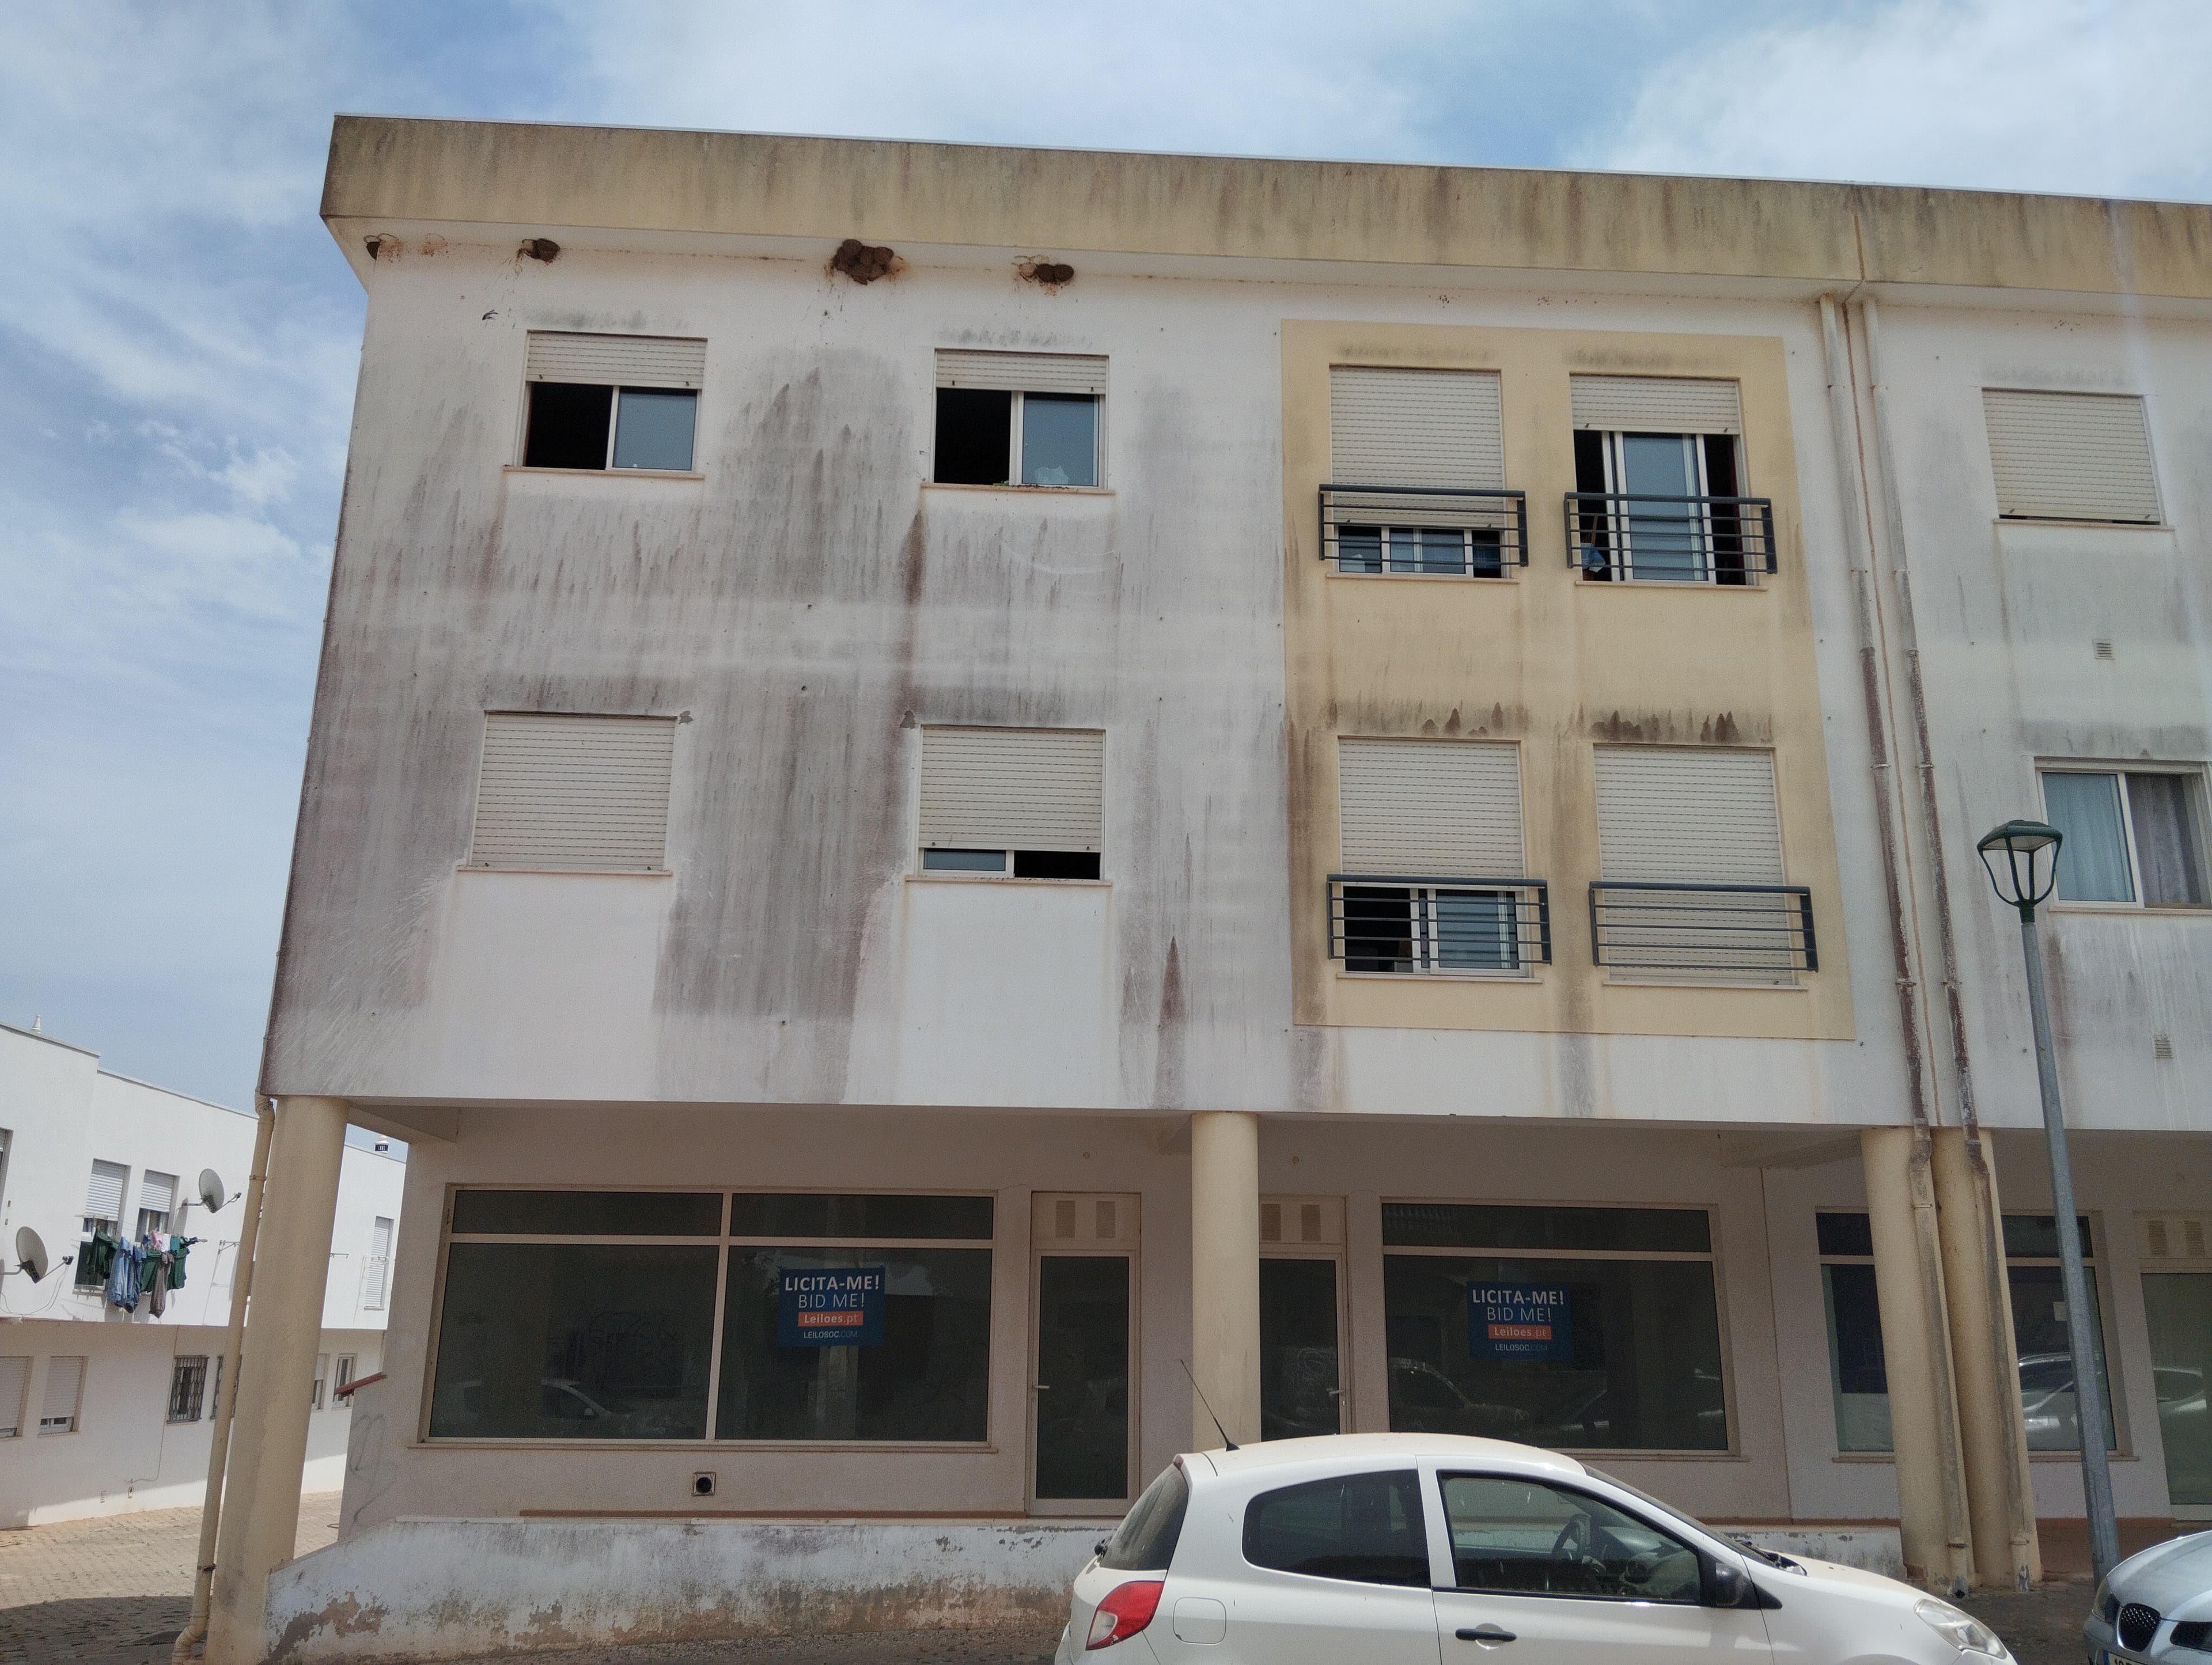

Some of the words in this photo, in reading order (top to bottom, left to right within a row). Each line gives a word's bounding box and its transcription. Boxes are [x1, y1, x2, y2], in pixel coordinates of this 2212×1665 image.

[785, 1275, 879, 1291] LICITA-ME!
[798, 1294, 825, 1309] BID
[833, 1292, 864, 1307] ME!
[1472, 1289, 1564, 1305] LICITA-ME!
[804, 1315, 858, 1325] Leiloes.pt
[1487, 1307, 1513, 1321] BID
[1521, 1307, 1551, 1322] ME!
[804, 1330, 858, 1338] LEILOSOC.COM
[1495, 1328, 1546, 1338] Leiloes.pt
